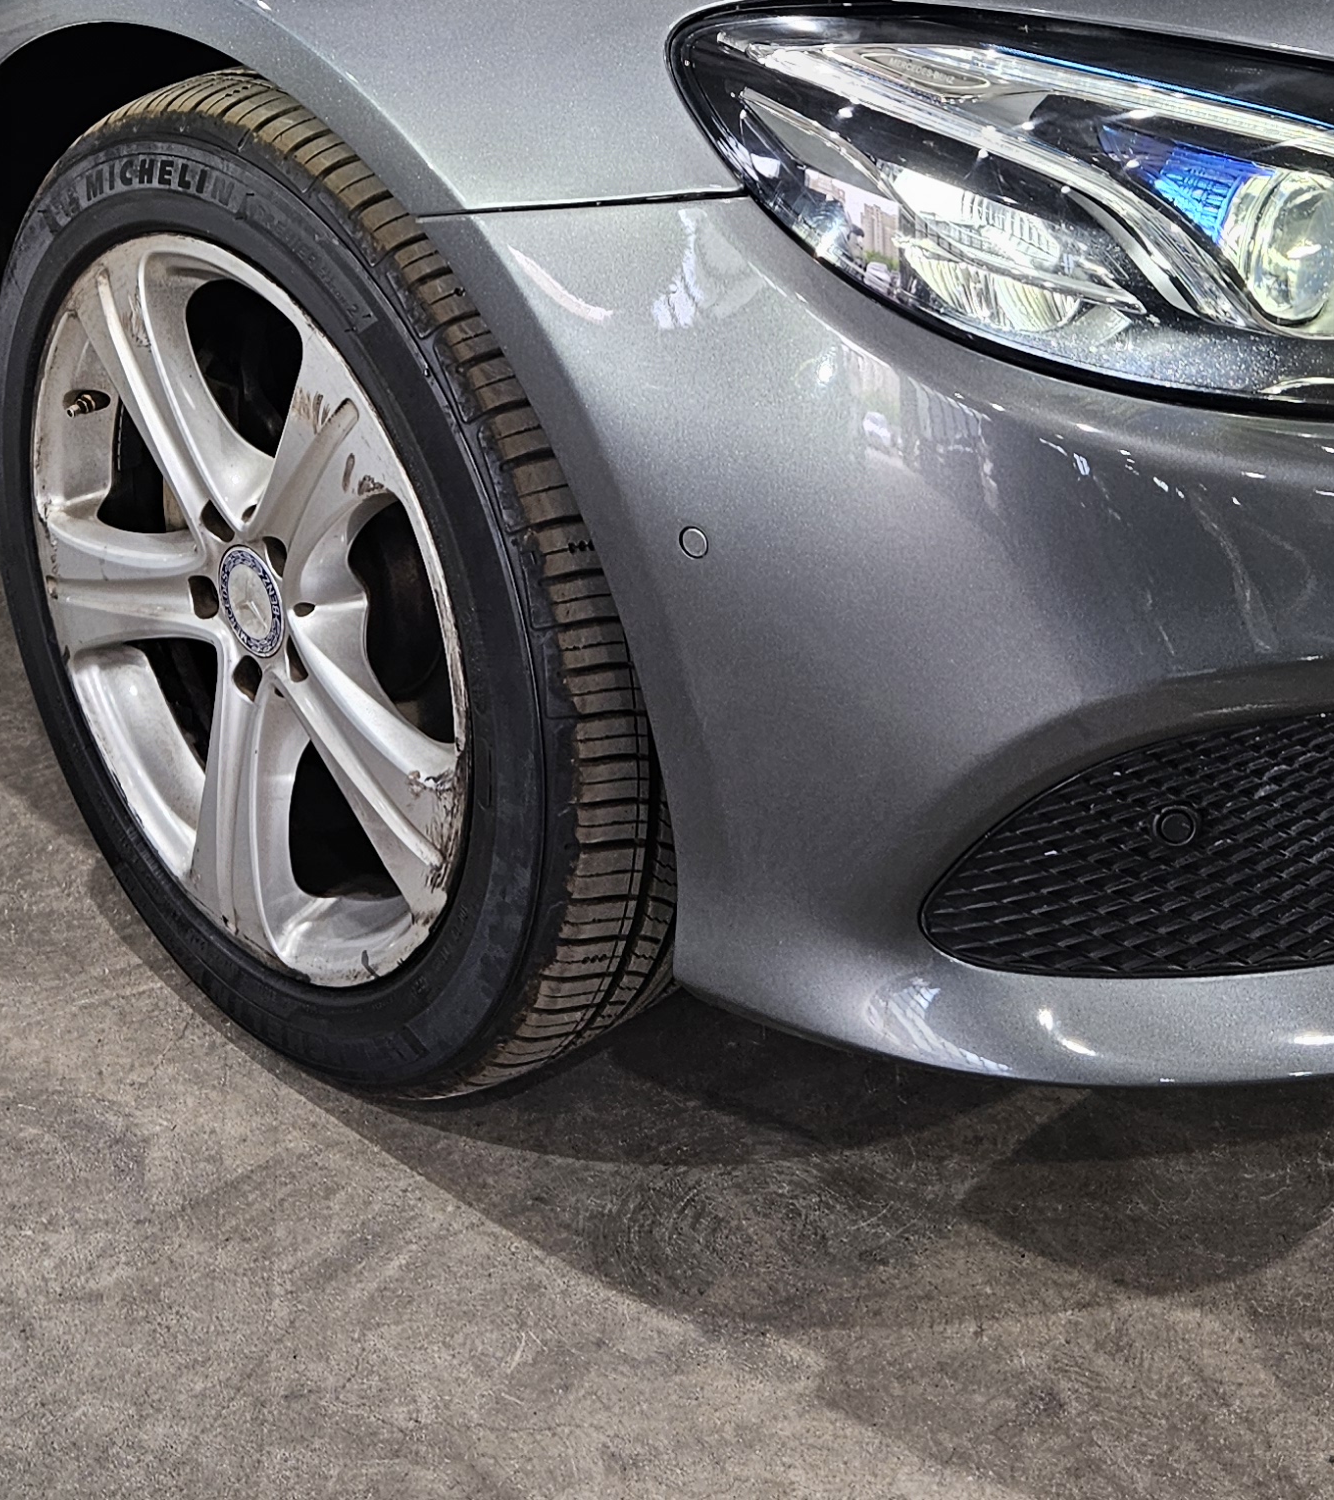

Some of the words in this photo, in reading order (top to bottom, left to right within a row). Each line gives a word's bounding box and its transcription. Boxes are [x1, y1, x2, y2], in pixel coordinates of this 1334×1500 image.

[889, 57, 956, 85] MERCEDES-BENZ
[84, 157, 236, 207] MICHELIN
[258, 567, 281, 616] BENZ
